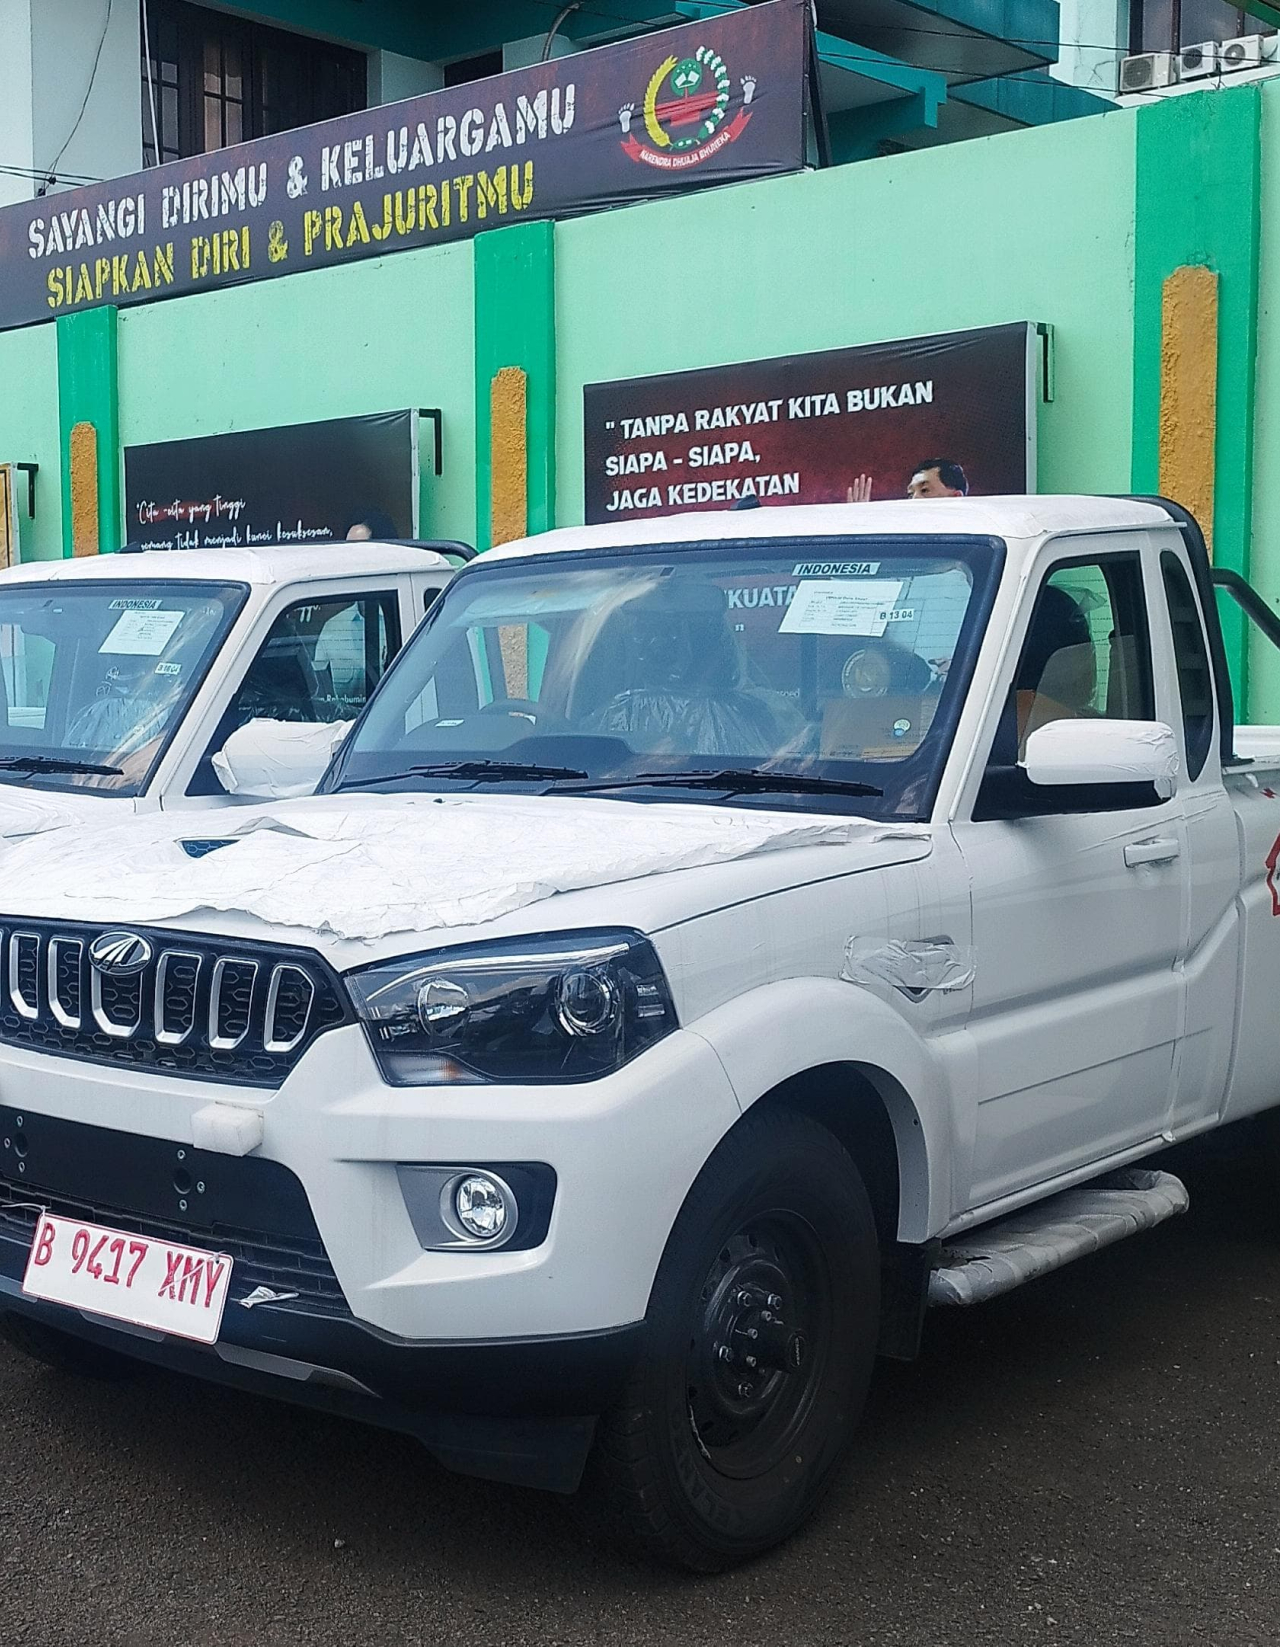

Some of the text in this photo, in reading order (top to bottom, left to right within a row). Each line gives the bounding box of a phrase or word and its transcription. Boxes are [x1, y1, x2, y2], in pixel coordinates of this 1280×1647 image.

[28, 84, 575, 259] SAYANGI DIRIMU & KELUARGAMU
[639, 149, 671, 167] NARENDRA
[47, 160, 534, 309] SIAPKAN DIRI & PRAJURITMU
[620, 413, 690, 439] TANPA
[695, 400, 783, 431] RAKYAT
[788, 392, 841, 420] KITA
[847, 380, 934, 413] BUKAN
[606, 450, 667, 477] SIAPA
[688, 441, 761, 468] SIAPA,
[606, 472, 800, 512] JAGA KEDEKATAN
[797, 564, 871, 575] INDONESIA
[113, 600, 156, 609] INDONESIA
[880, 612, 887, 620] B
[889, 611, 899, 619] 13
[34, 1222, 225, 1309] B 9417 XMY
